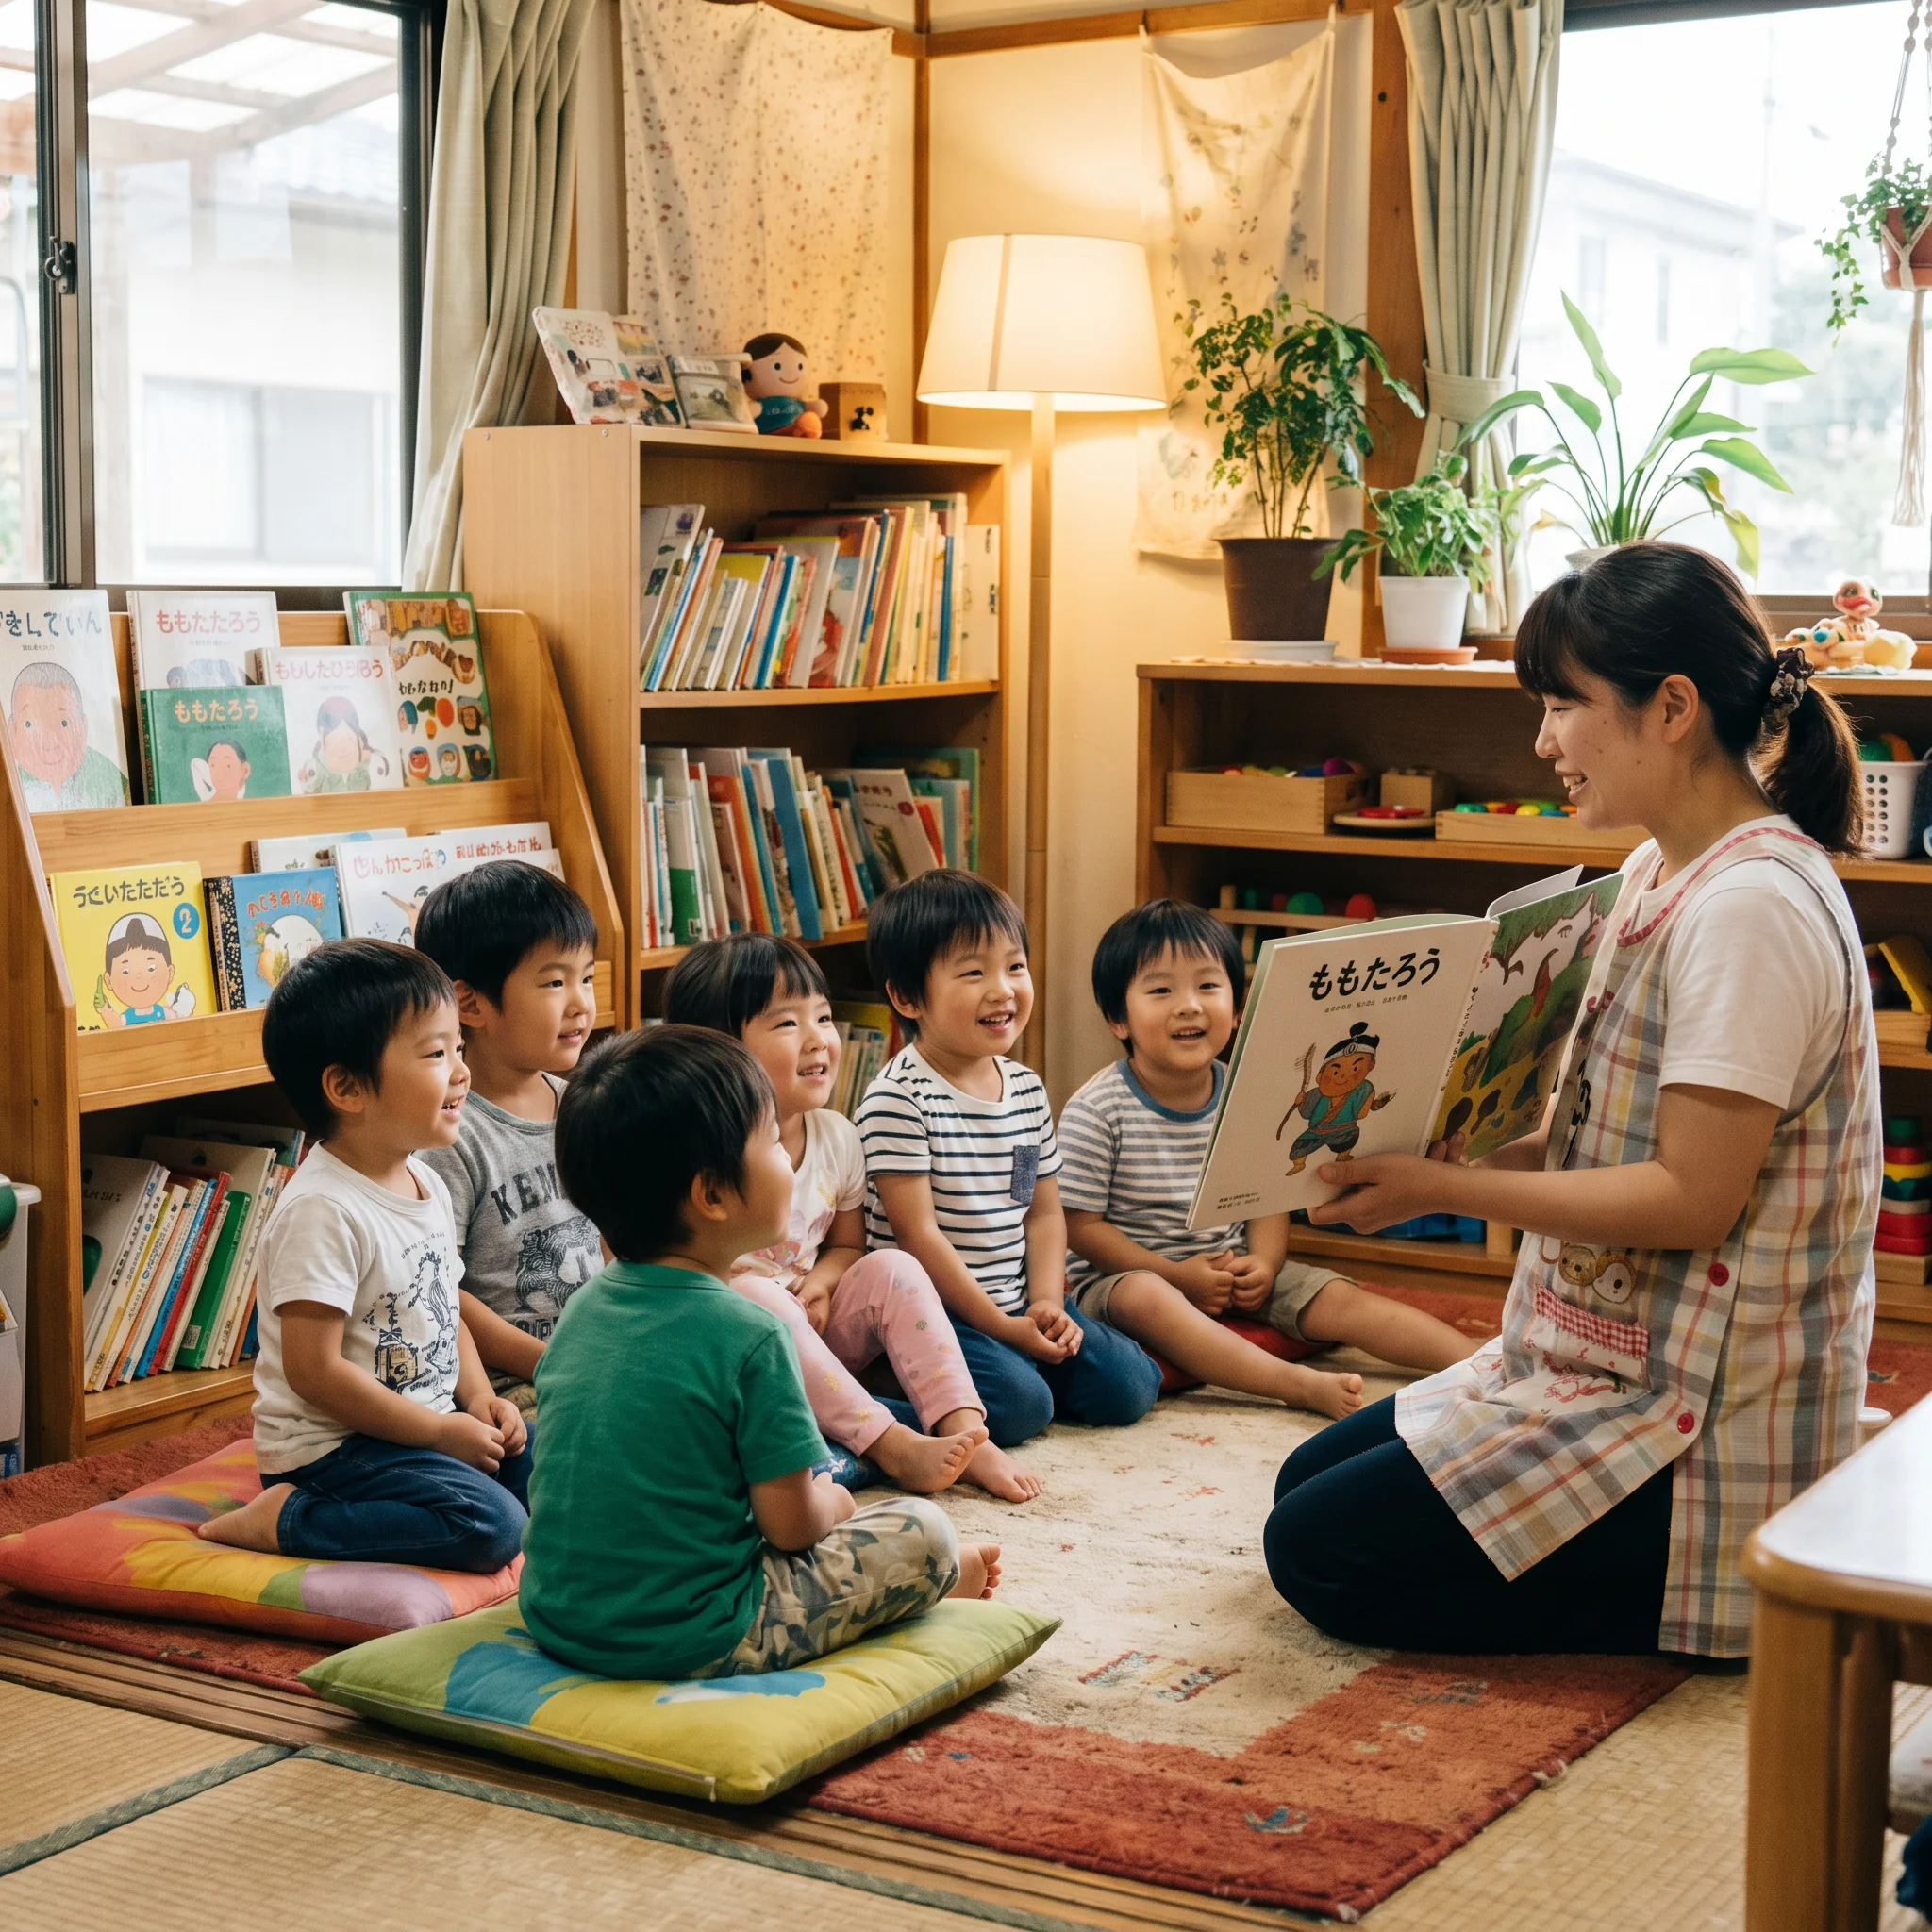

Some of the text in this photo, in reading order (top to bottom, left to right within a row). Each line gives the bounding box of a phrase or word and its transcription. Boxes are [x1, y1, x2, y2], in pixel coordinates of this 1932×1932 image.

[157, 610, 260, 634] ももたたろう
[175, 698, 258, 724] ももたろう
[179, 908, 192, 933] 2
[1309, 948, 1440, 1001] ももたろう
